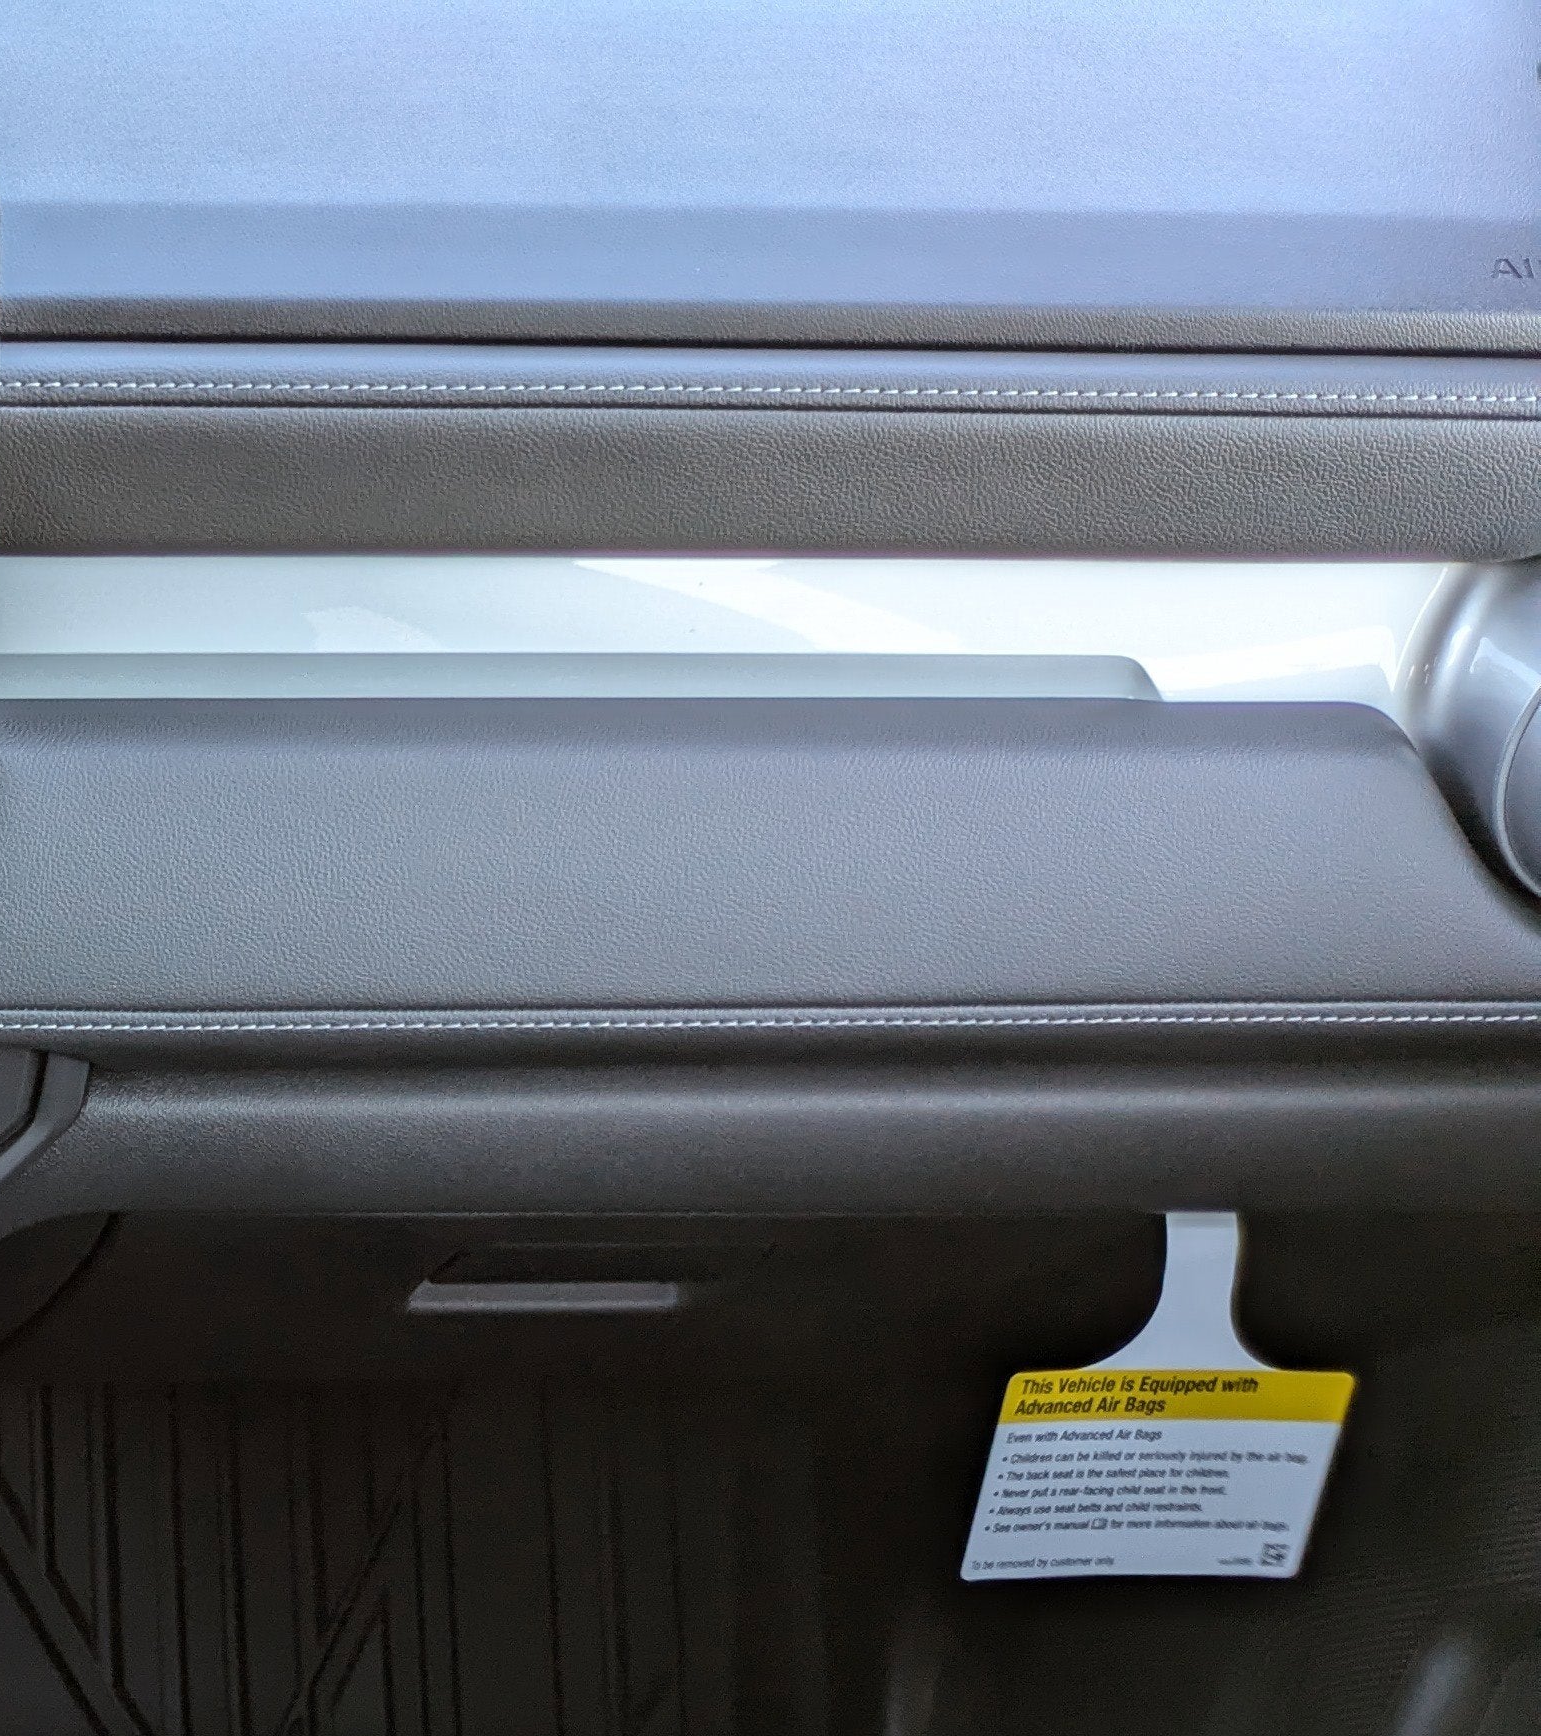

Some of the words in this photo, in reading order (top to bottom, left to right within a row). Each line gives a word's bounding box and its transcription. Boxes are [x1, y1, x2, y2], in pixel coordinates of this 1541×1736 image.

[1022, 1378, 1053, 1395] This
[1059, 1376, 1116, 1394] Vehicle
[1121, 1376, 1135, 1392] is
[1139, 1375, 1218, 1395] Equipped
[1221, 1377, 1259, 1393] with
[1015, 1397, 1093, 1415] Advanced
[1096, 1396, 1121, 1413] Air
[1124, 1396, 1167, 1416] Bags
[1006, 1432, 1032, 1444] Even
[1035, 1431, 1059, 1442] with
[1060, 1429, 1114, 1442] Advanced
[1115, 1428, 1132, 1440] Air
[1134, 1428, 1163, 1442] Bags
